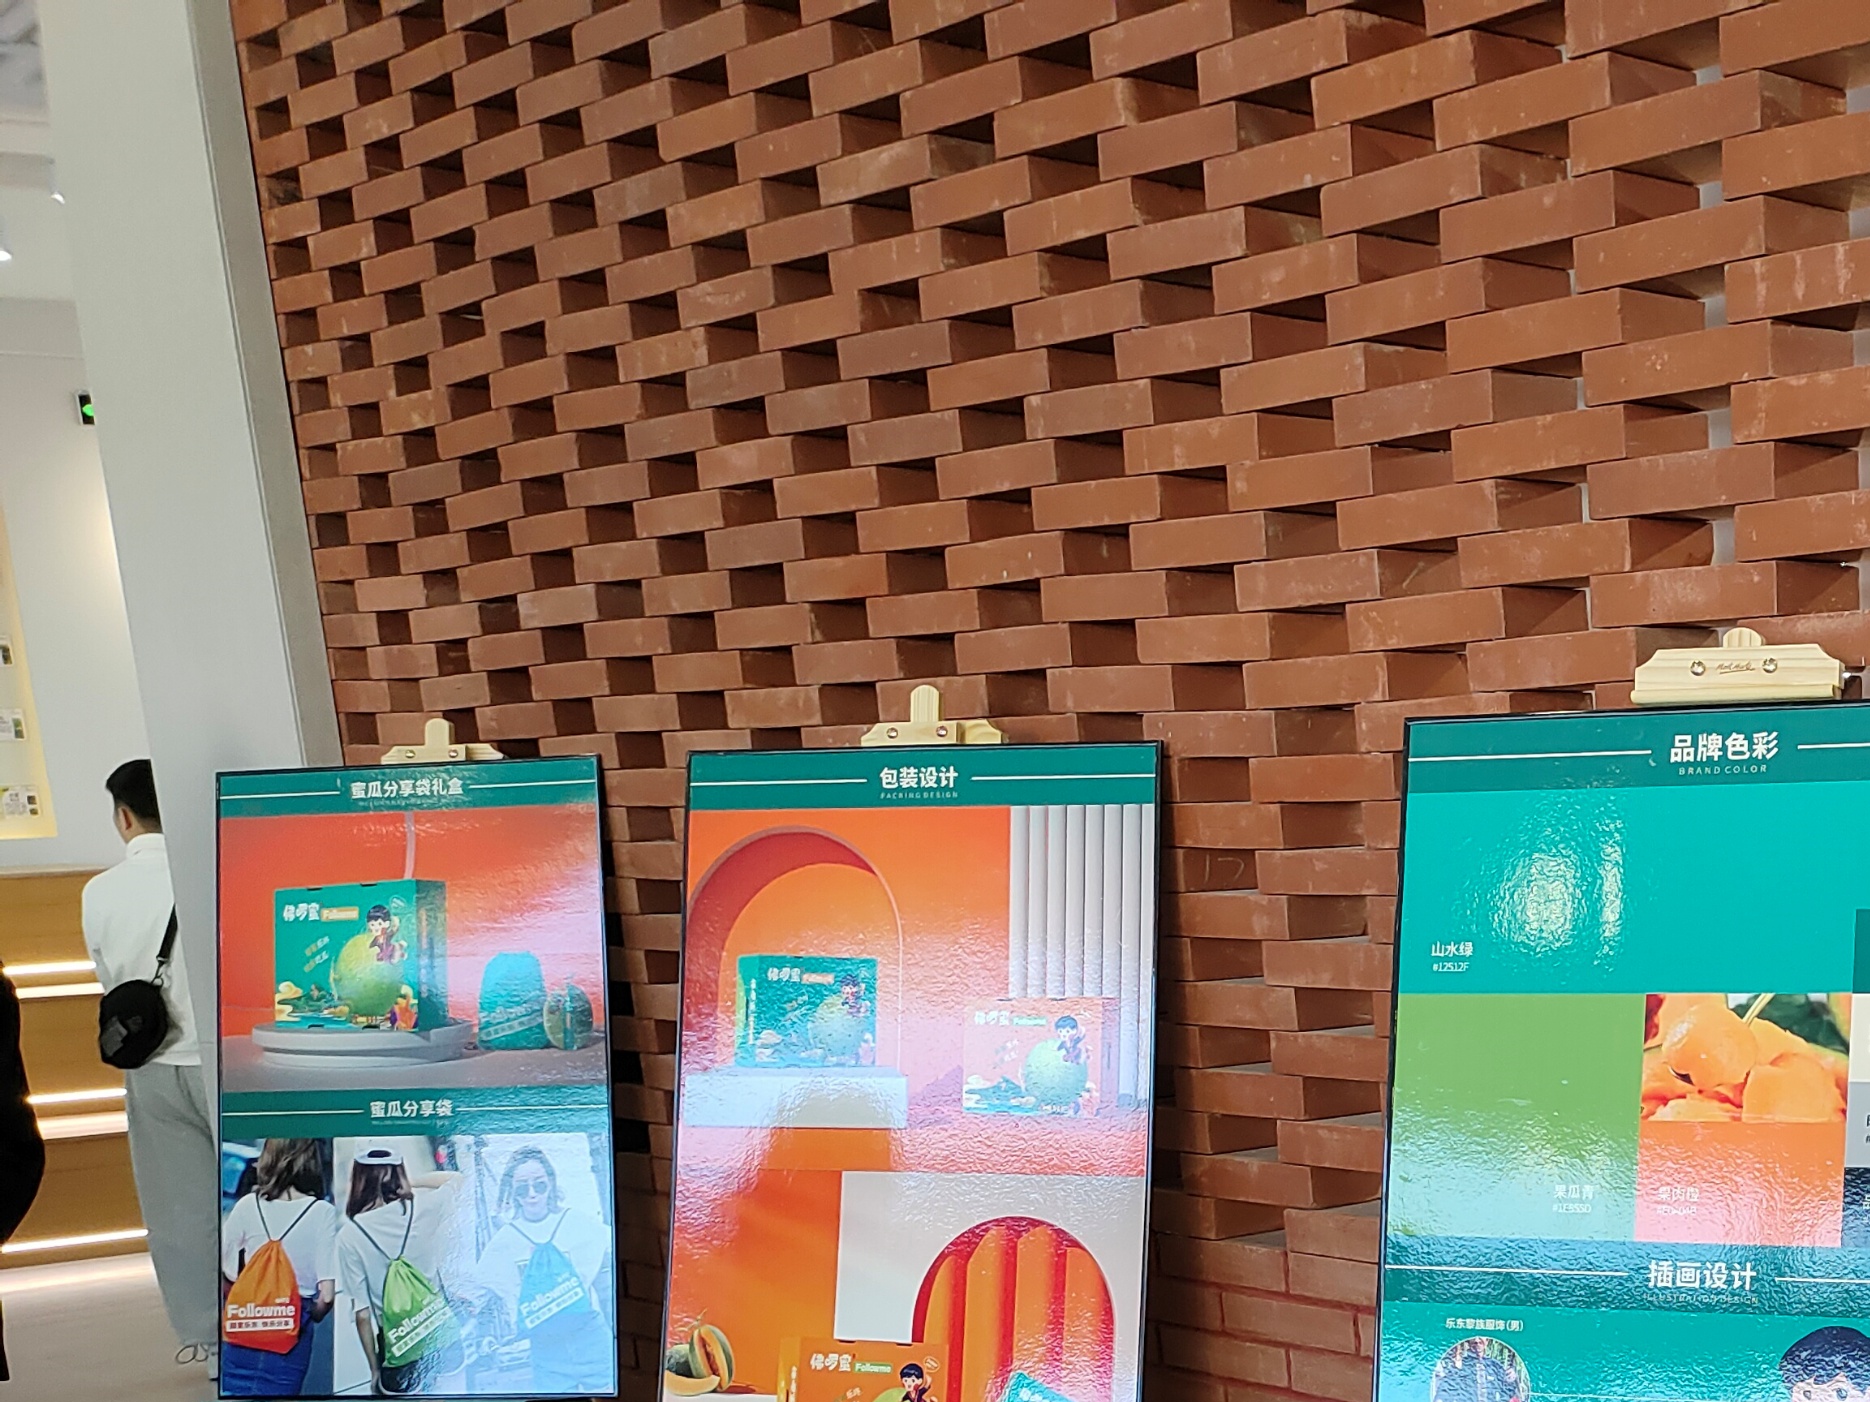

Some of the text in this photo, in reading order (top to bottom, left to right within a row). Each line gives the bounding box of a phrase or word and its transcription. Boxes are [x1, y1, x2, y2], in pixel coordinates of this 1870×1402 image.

[1669, 731, 1779, 763] 品牌色彩
[879, 765, 959, 789] 包装设计
[1678, 764, 1767, 775] BRAND COLOR
[350, 777, 464, 799] 蜜瓜分享袋礼盒
[1430, 940, 1474, 958] 山水绿
[369, 1099, 454, 1118] 蜜瓜分享袋
[1648, 1259, 1757, 1291] 插画设计
[227, 1303, 296, 1319] Followme
